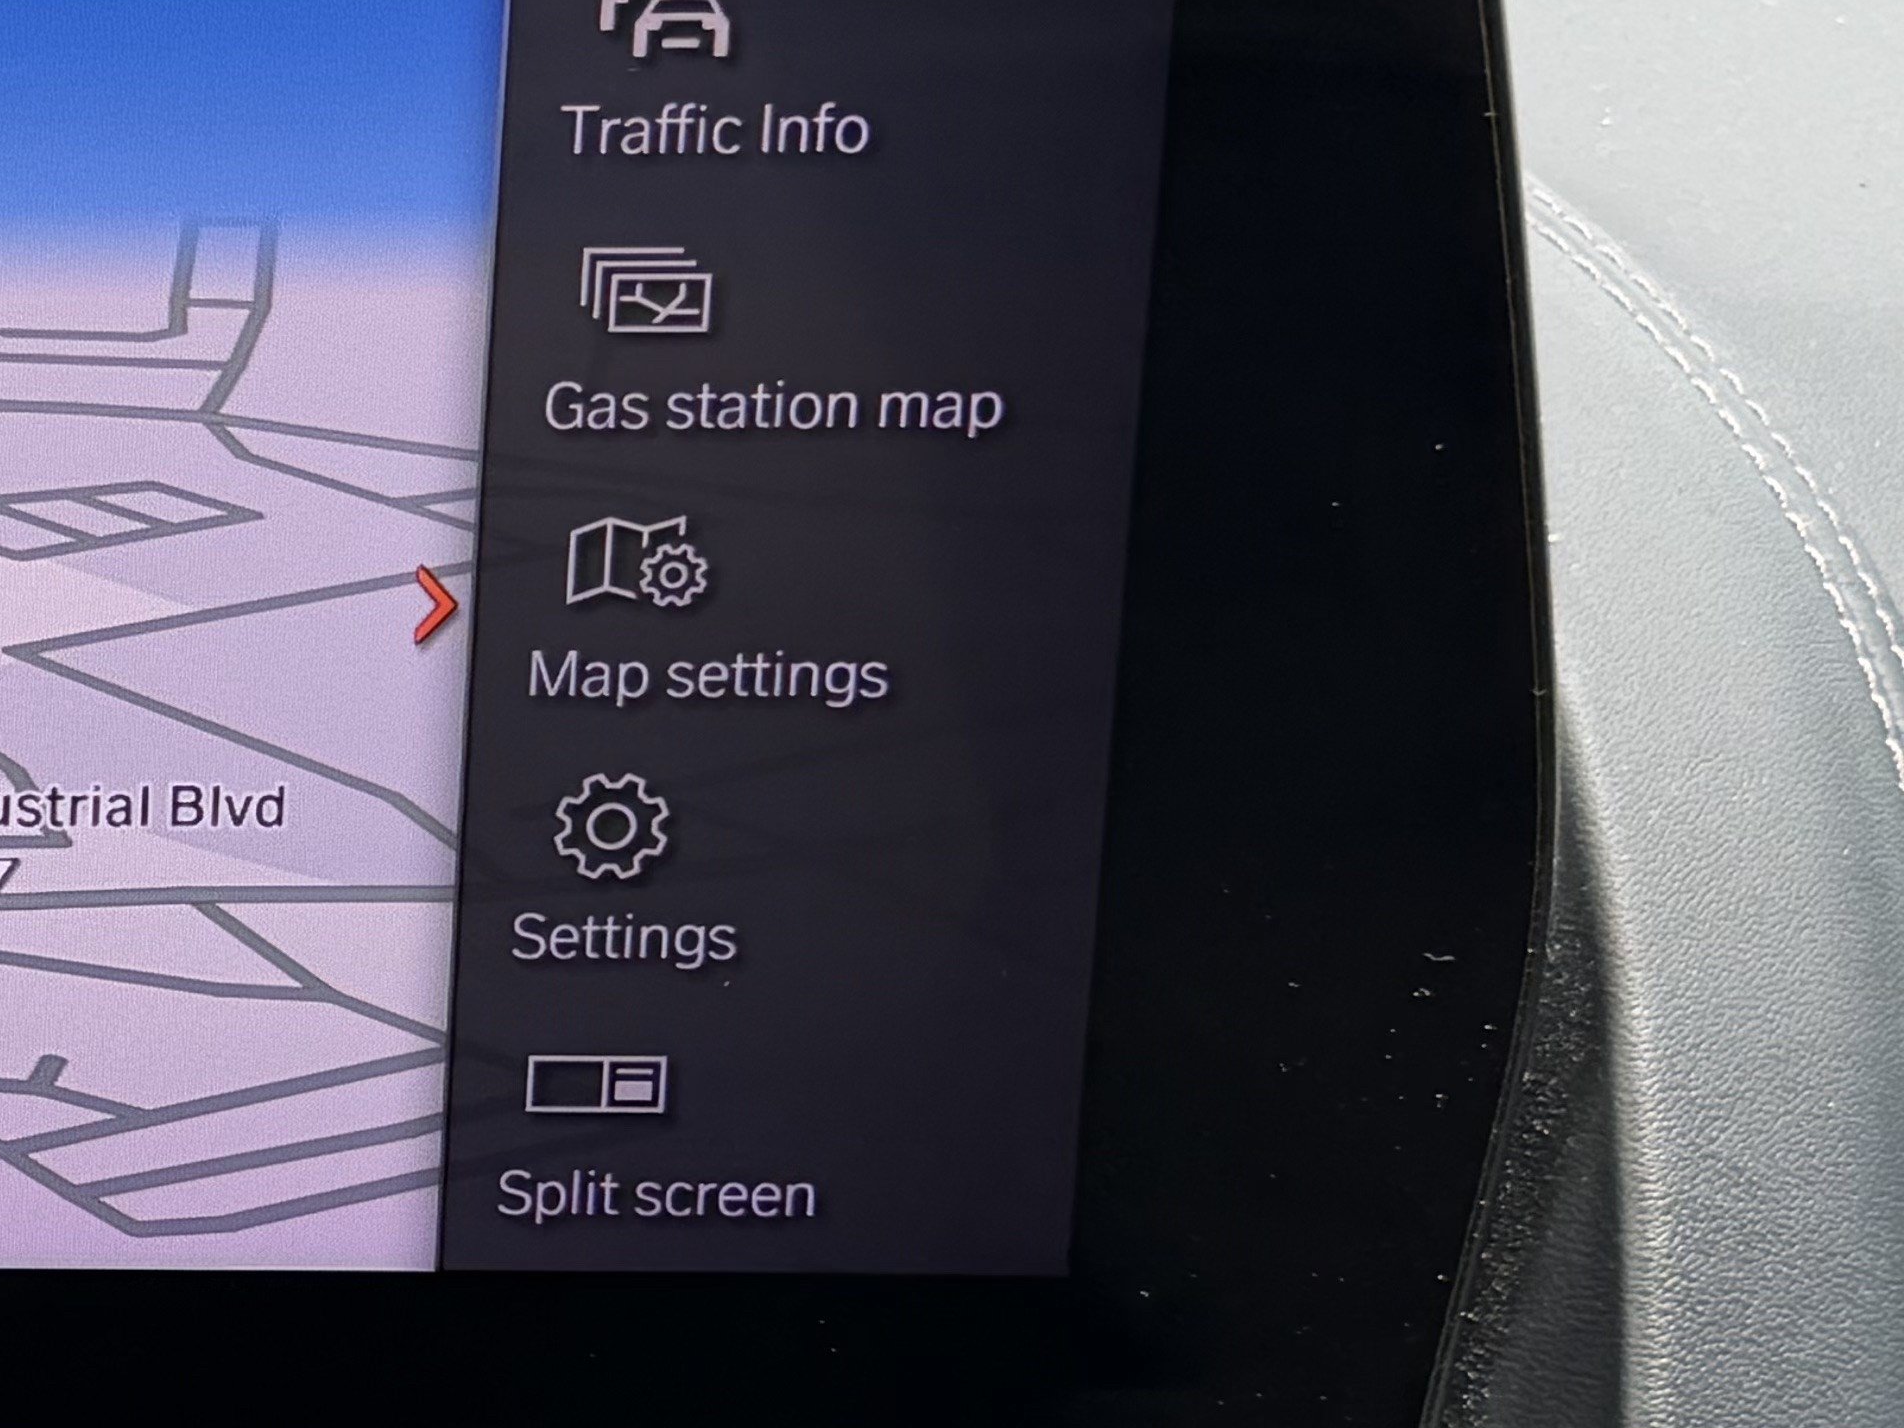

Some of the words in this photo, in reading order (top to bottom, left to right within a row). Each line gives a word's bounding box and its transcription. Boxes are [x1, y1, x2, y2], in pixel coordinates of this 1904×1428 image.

[560, 102, 743, 155] Traffic
[761, 101, 870, 154] Info
[545, 380, 649, 430] Gas
[666, 379, 858, 430] station
[878, 391, 1003, 439] map
[529, 649, 649, 708] Map
[666, 649, 889, 708] settings
[170, 785, 285, 829] Blvd
[511, 912, 738, 970] Settings
[497, 1169, 619, 1225] Split
[634, 1180, 816, 1218] screen
